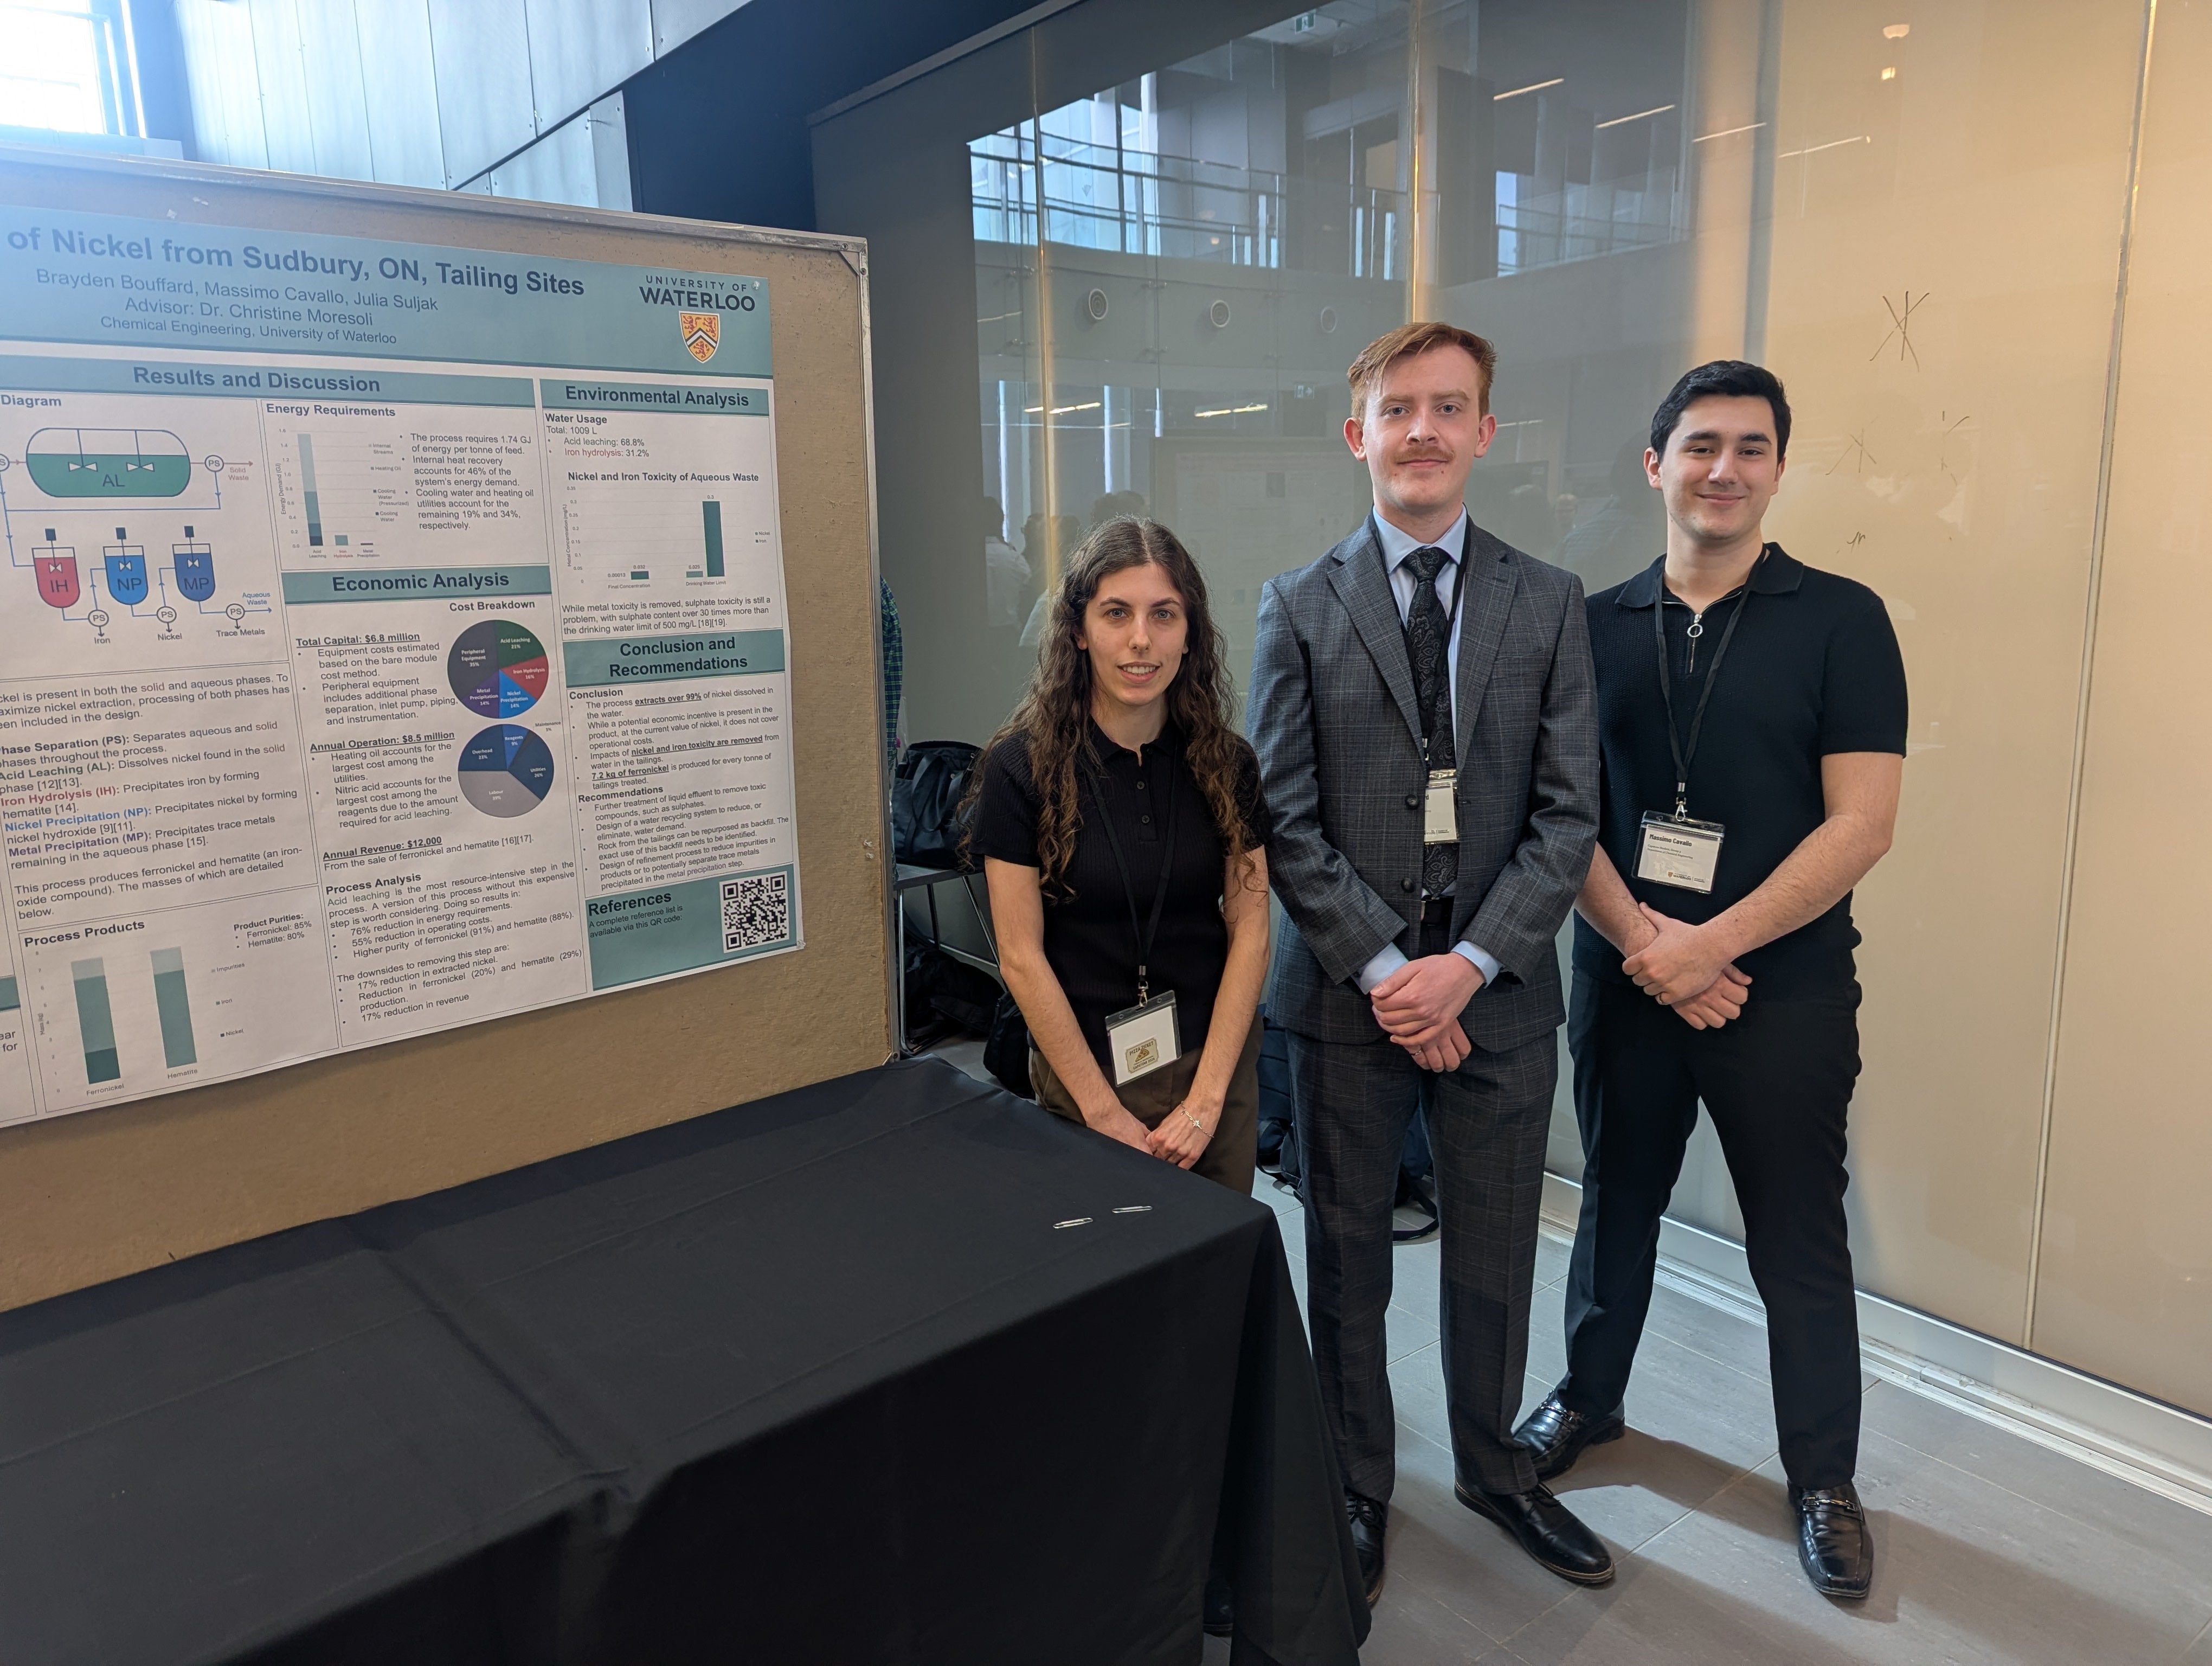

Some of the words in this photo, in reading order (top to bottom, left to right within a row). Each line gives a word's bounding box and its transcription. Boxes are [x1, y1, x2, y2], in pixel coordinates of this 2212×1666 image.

[8, 228, 40, 250] of
[53, 229, 152, 260] Nickel
[162, 239, 233, 266] from
[243, 246, 369, 281] Sudbury,
[379, 257, 427, 286] ON,
[435, 262, 518, 294] Tailing
[526, 271, 584, 295] Sites
[37, 269, 114, 289] Brayden
[121, 275, 198, 297] Bouffard,
[205, 281, 279, 299] Massimo
[285, 287, 348, 306] Cavallo,
[353, 292, 394, 307] Julia
[394, 295, 438, 312] Suljak
[646, 275, 725, 291] UNIVERSITY
[732, 284, 747, 292] OF
[639, 287, 755, 311] WATERLOO
[125, 297, 194, 315] Advisor:
[200, 302, 223, 317] Dr.
[229, 304, 301, 321] Christine
[307, 309, 372, 326] Moresoli
[101, 316, 166, 331] Chemical
[171, 321, 255, 338] Engineering,
[260, 325, 323, 342] University
[327, 329, 339, 340] of
[342, 330, 396, 344] Waterloo
[134, 367, 215, 386] Results
[222, 366, 261, 388] and
[268, 367, 381, 392] Discussion
[1, 394, 61, 408] Diagram
[566, 385, 680, 404] Environmental
[685, 392, 749, 407] Analysis
[266, 401, 310, 416] Energy
[314, 401, 396, 416] Requirements
[545, 414, 573, 423] Water
[576, 415, 607, 425] Usage
[546, 426, 568, 434] Total:
[412, 433, 427, 441] The
[466, 435, 498, 444] requires
[520, 435, 531, 444] GJ
[583, 438, 618, 447] leaching:
[621, 438, 645, 446] 68.8%
[413, 456, 445, 464] Internal
[447, 456, 466, 464] heat
[468, 458, 503, 466] recovery
[582, 448, 623, 458] hydrolysis:
[626, 449, 649, 457] 31.2%
[102, 475, 125, 487] AL
[568, 472, 597, 480] Nickel
[601, 472, 619, 480] and
[621, 472, 639, 480] Iron
[644, 472, 677, 483] Toxicity
[679, 473, 688, 481] of
[690, 473, 730, 483] Aqueous
[732, 473, 758, 481] Waste
[50, 579, 68, 593] IH
[117, 578, 142, 591] NP
[184, 578, 209, 589] MP
[333, 575, 428, 591] Economic
[433, 572, 510, 590] Analysis
[449, 603, 474, 611] Cost
[477, 600, 535, 610] Breakdown
[562, 604, 585, 613] While
[587, 603, 609, 612] metal
[611, 602, 638, 611] toxicity
[649, 600, 683, 608] removed,
[685, 599, 716, 608] sulphate
[717, 597, 743, 606] toxicity
[296, 638, 320, 647] Total
[324, 636, 362, 646] Capital:
[365, 634, 385, 643] $6.8
[388, 632, 420, 642] million
[620, 639, 704, 656] Conclusion
[709, 636, 735, 650] and
[609, 656, 748, 677] Recommendations
[569, 688, 623, 700] Conclusion
[311, 742, 345, 752] Annual
[348, 738, 400, 749] Operation:
[402, 734, 422, 744] $8.5
[424, 731, 455, 741] million
[1, 798, 25, 806] Iron
[29, 789, 92, 804] Hydrolysis
[96, 786, 119, 798] (IH):
[123, 780, 184, 793] Precipitates
[187, 778, 206, 786] iron
[209, 775, 221, 785] by
[223, 771, 259, 781] forming
[578, 787, 663, 803] Recommendations
[1649, 834, 1671, 843] Massimo
[324, 848, 358, 860] Annual
[361, 842, 405, 856] Revenue:
[407, 836, 442, 849] $12,000
[326, 882, 372, 895] Process
[375, 873, 421, 887] Analysis
[589, 892, 672, 917] References
[234, 919, 267, 931] Product
[269, 914, 304, 925] Purities:
[596, 915, 629, 927] complete
[631, 909, 664, 920] reference
[24, 932, 80, 947] Process
[85, 921, 145, 938] Products
[247, 924, 292, 939] Ferronickel:
[294, 920, 312, 930] 85%
[590, 926, 621, 938] available
[635, 921, 648, 929] this
[650, 918, 662, 926] QR
[664, 915, 682, 923] code:
[248, 936, 285, 948] Hematite:
[287, 931, 305, 940] 80%
[217, 963, 245, 972] Impurities
[362, 1011, 381, 1022] 17%
[384, 1004, 423, 1017] reduction
[436, 994, 469, 1006] revenue
[226, 1028, 244, 1036] Nickel
[1129, 1047, 1141, 1056] PIZZA
[168, 1069, 197, 1079] Hematite
[86, 1083, 124, 1096] Ferronickel
